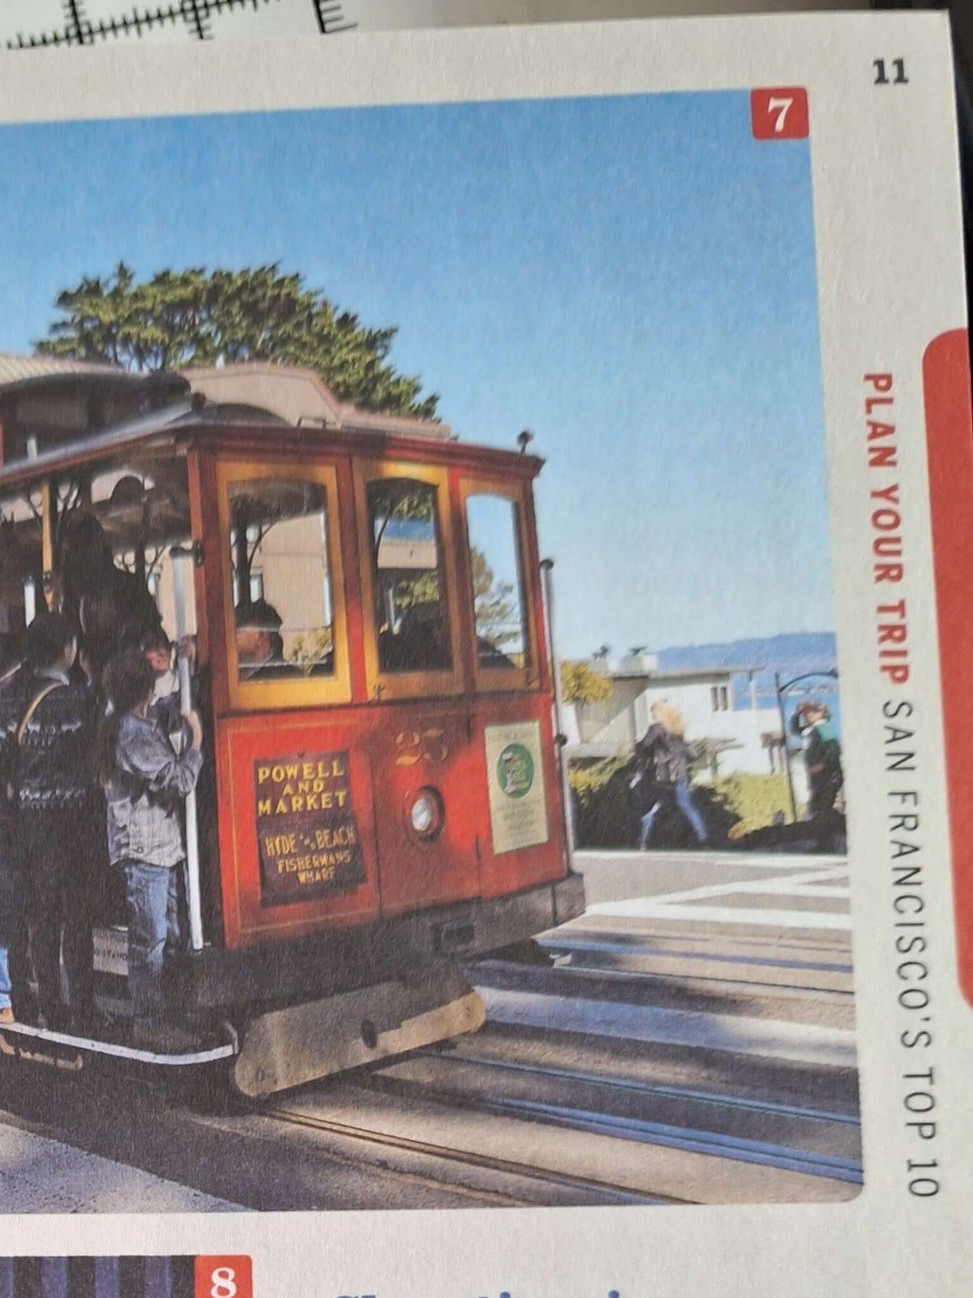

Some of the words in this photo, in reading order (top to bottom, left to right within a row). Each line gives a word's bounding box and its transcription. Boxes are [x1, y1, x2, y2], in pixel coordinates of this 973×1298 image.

[871, 56, 909, 87] 11
[768, 96, 794, 133] 7
[863, 373, 898, 468] PLAN
[870, 483, 904, 584] YOUR
[876, 598, 910, 685] TRIP
[882, 700, 917, 772] SAN
[258, 759, 345, 784] POWELL
[283, 780, 324, 796] AND
[258, 791, 346, 816] MARKET
[266, 834, 298, 856] HYDE
[314, 825, 356, 850] BEACH
[887, 791, 933, 1049] FRANCISCO'S
[902, 1066, 938, 1141] TOP
[907, 1159, 941, 1198] 10
